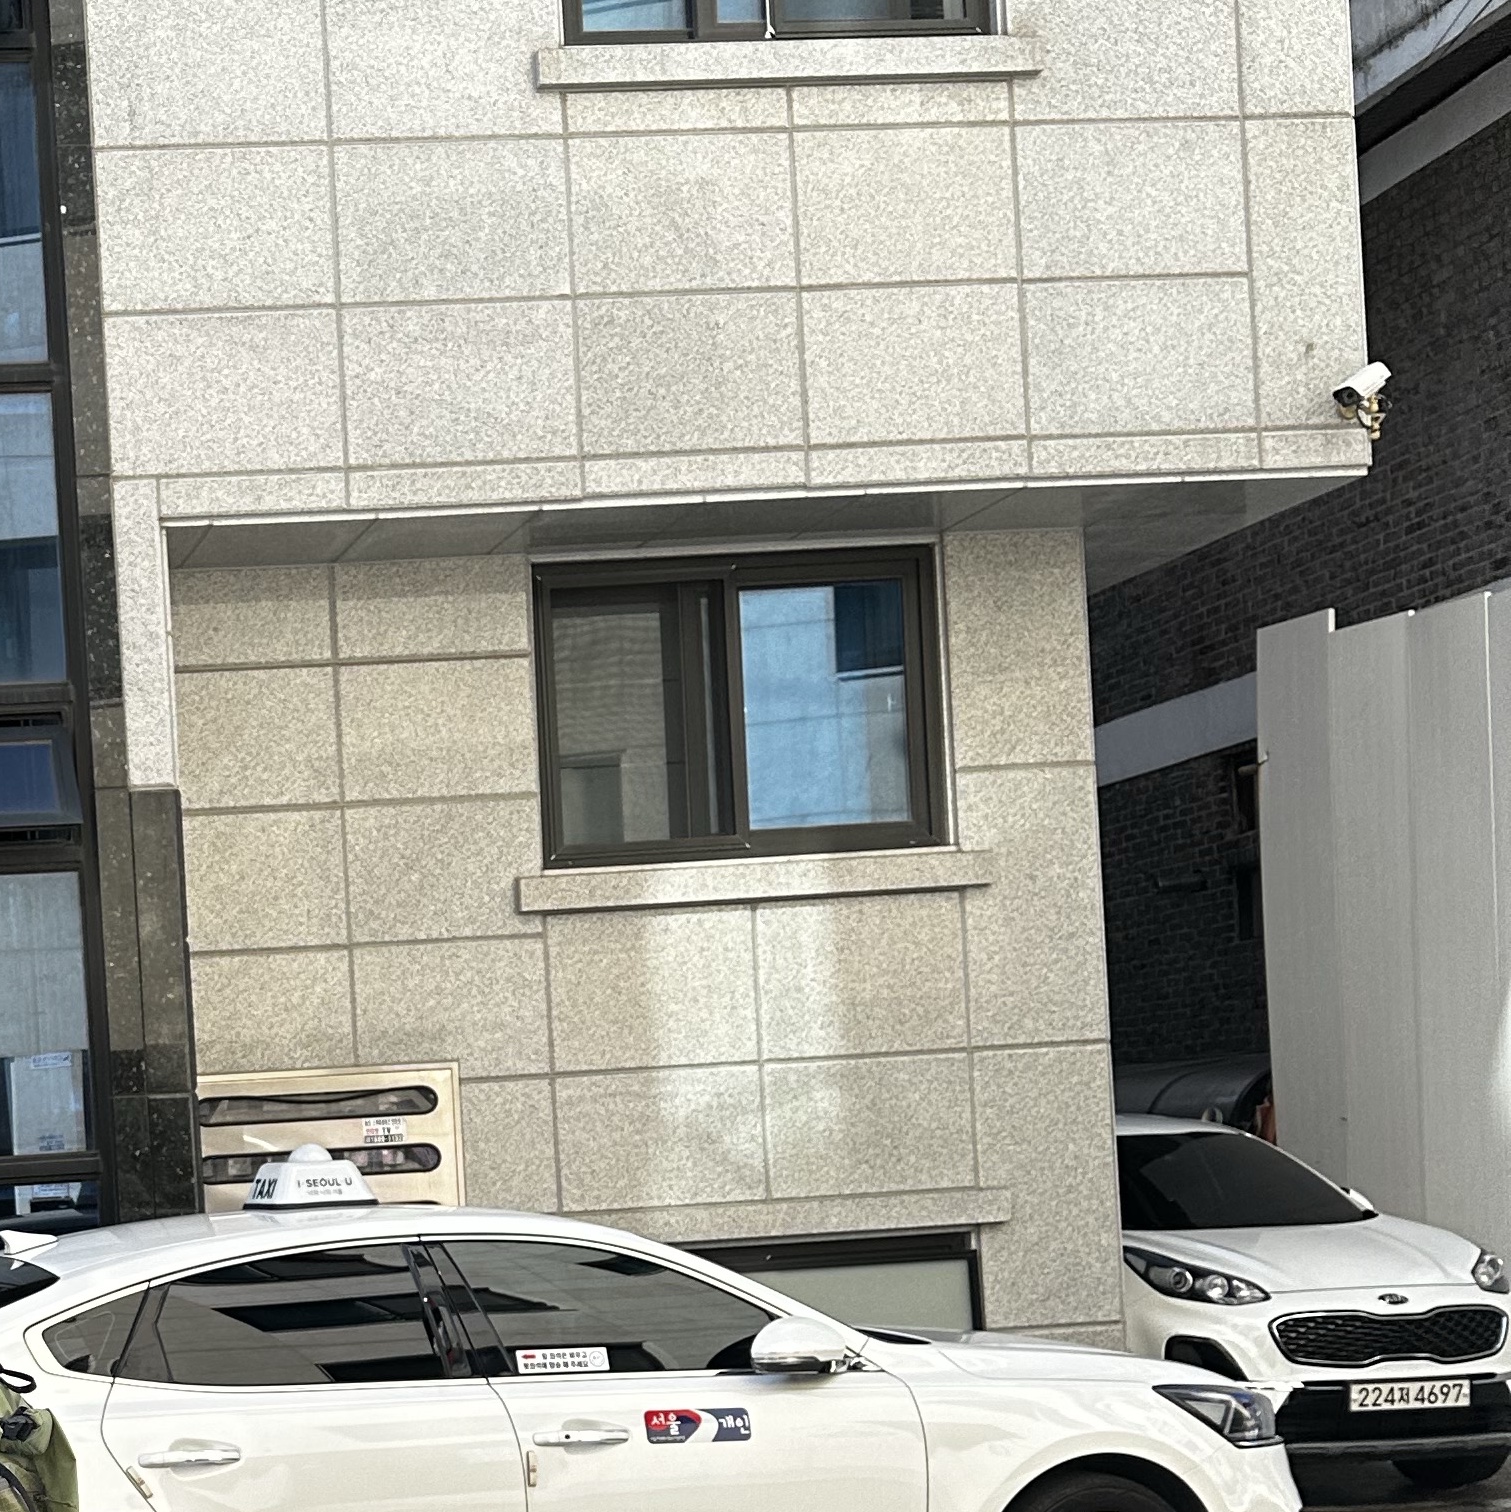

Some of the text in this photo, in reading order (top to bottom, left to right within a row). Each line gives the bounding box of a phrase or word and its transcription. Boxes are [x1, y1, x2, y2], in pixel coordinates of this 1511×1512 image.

[252, 1179, 277, 1199] TAXI
[651, 1413, 750, 1435] 서울 개인
